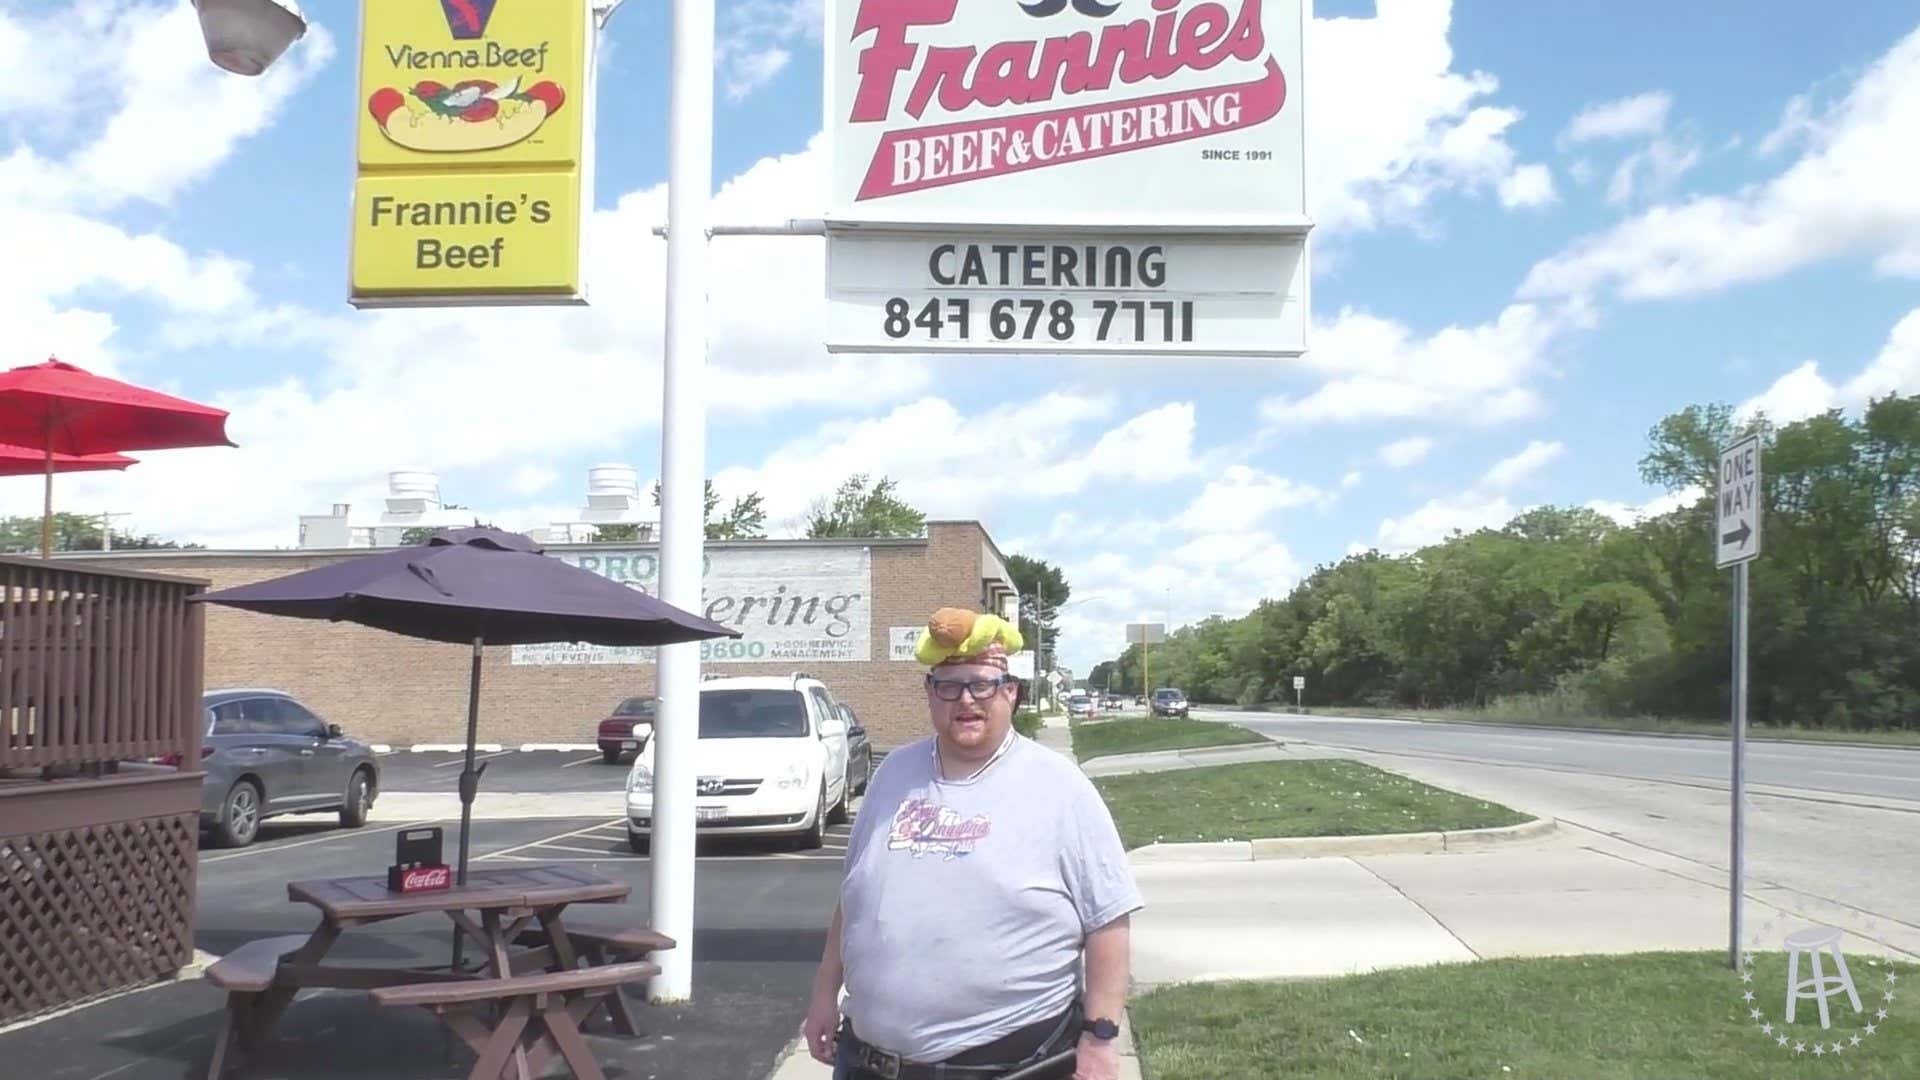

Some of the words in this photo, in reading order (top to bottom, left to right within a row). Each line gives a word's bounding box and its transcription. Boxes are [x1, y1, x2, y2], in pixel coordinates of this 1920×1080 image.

[385, 44, 480, 69] Vienna
[486, 42, 548, 73] Beef
[1201, 149, 1240, 161] SINCE
[1245, 149, 1273, 161] 1991
[371, 194, 551, 226] Frannie's
[416, 238, 504, 270] Beef
[928, 244, 1167, 288] CATERING
[989, 299, 1075, 341] 678
[1723, 448, 1754, 485] ONE
[1722, 481, 1754, 518] WAY
